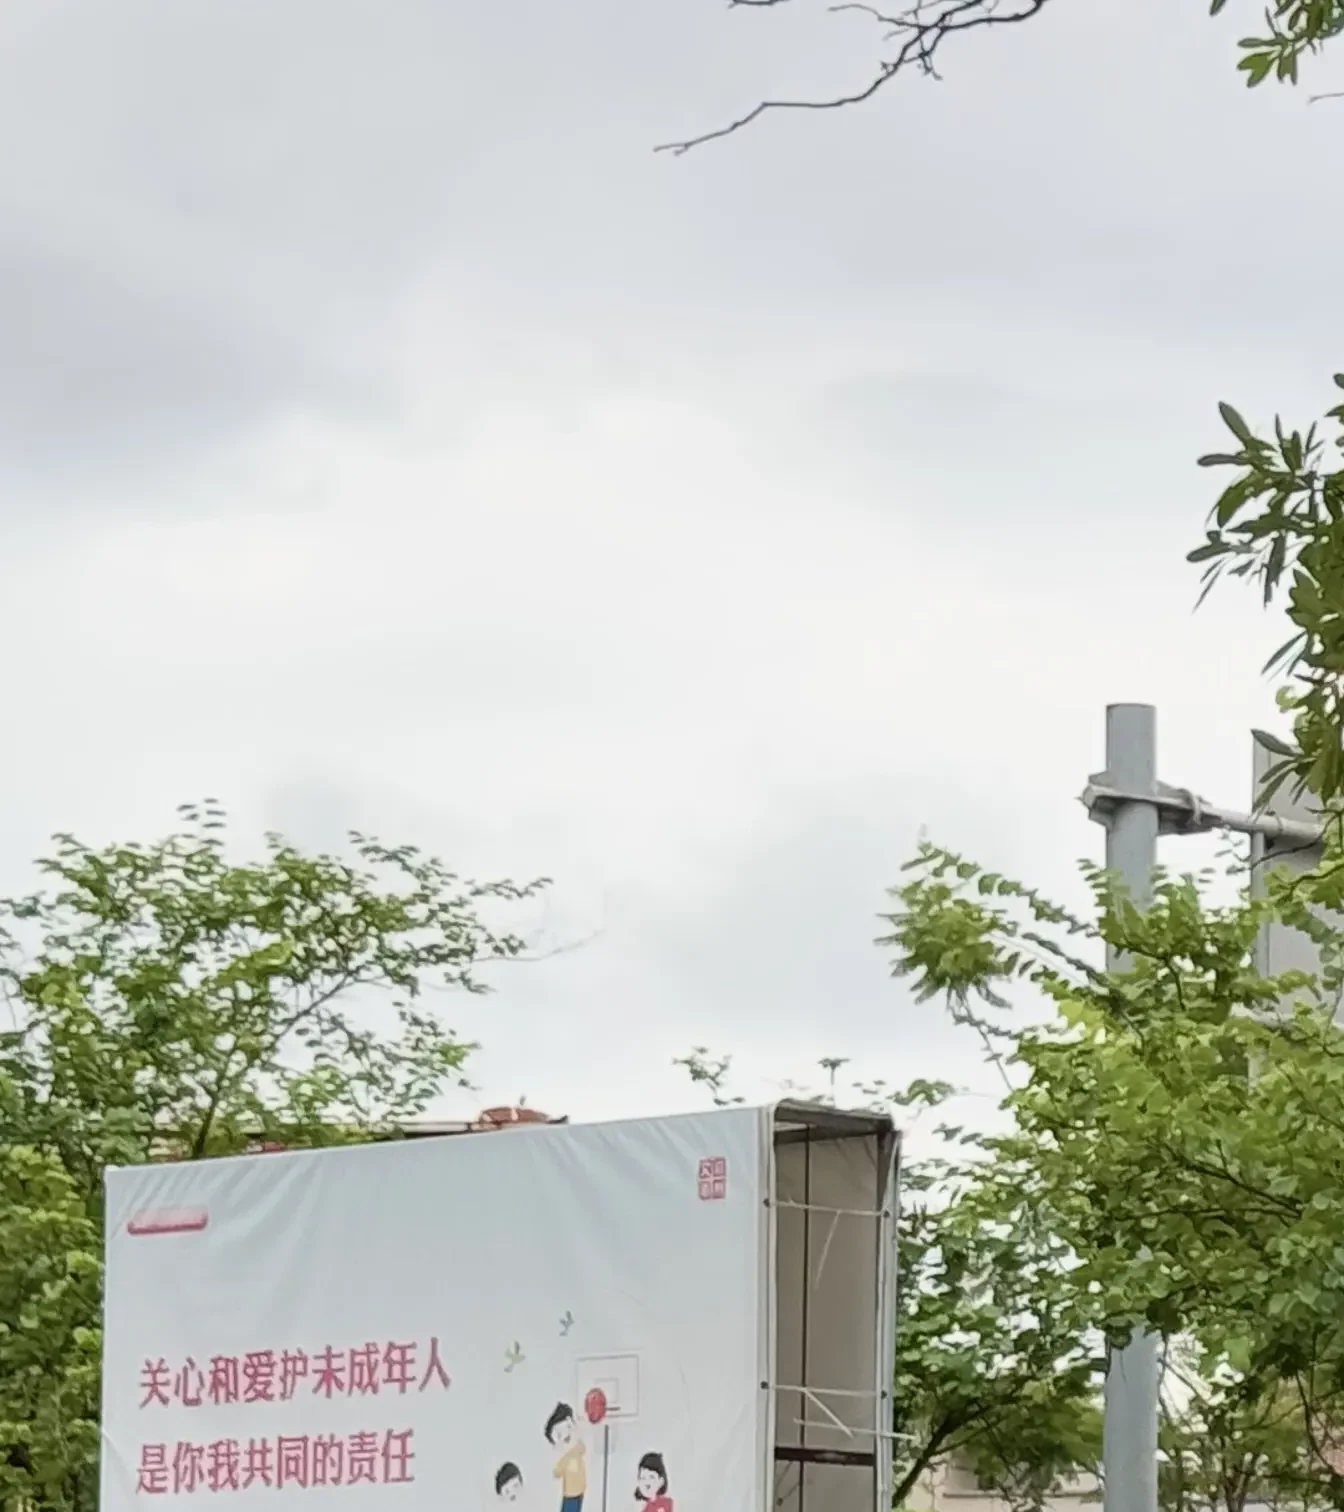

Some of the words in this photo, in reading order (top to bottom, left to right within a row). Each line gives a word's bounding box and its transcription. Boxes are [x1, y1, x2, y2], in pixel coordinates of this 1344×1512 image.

[139, 1337, 451, 1409] 关心和爱护未成年人
[136, 1428, 416, 1495] 是你我共同的责任
